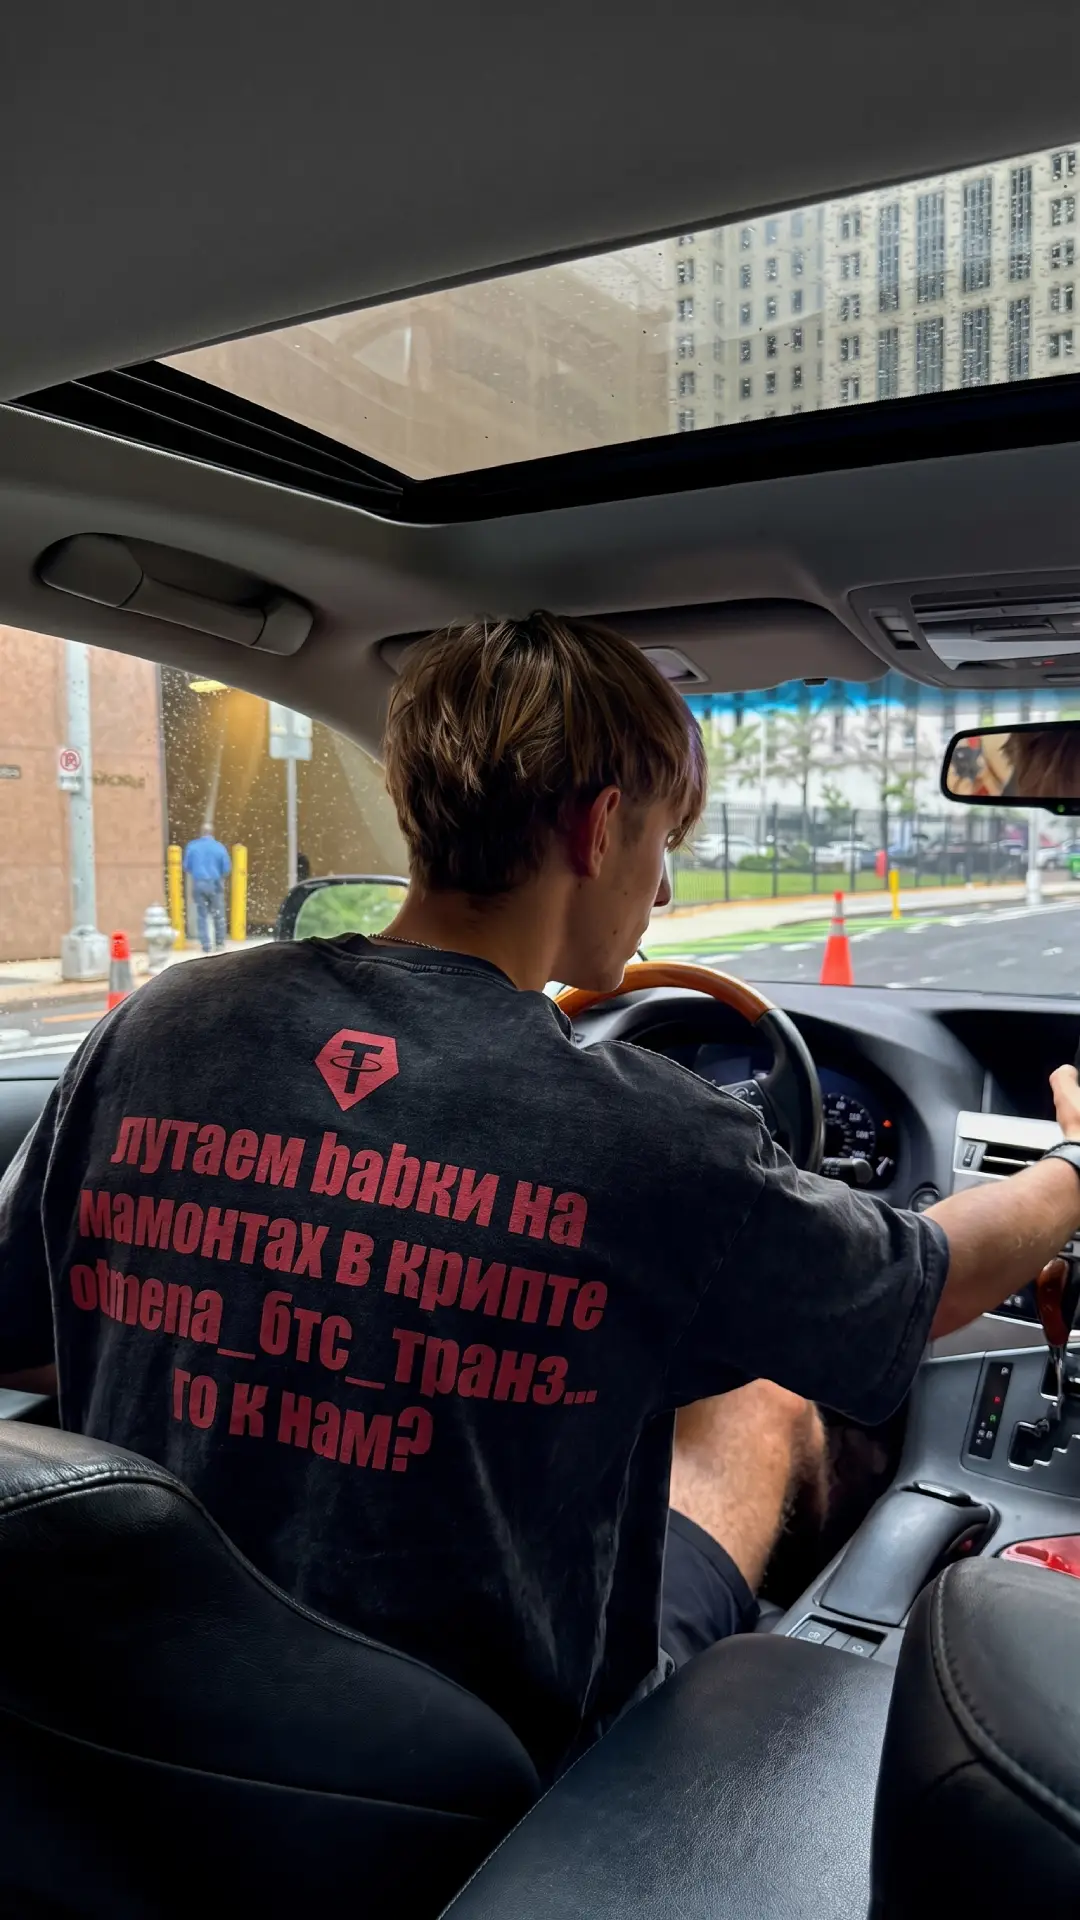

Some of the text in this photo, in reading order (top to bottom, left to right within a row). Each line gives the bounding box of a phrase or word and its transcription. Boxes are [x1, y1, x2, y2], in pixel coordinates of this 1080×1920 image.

[111, 1116, 305, 1189] лутаем
[508, 1181, 588, 1249] на
[79, 1189, 608, 1331] мамонтах в крипте
[173, 1368, 433, 1472] го к нам?
